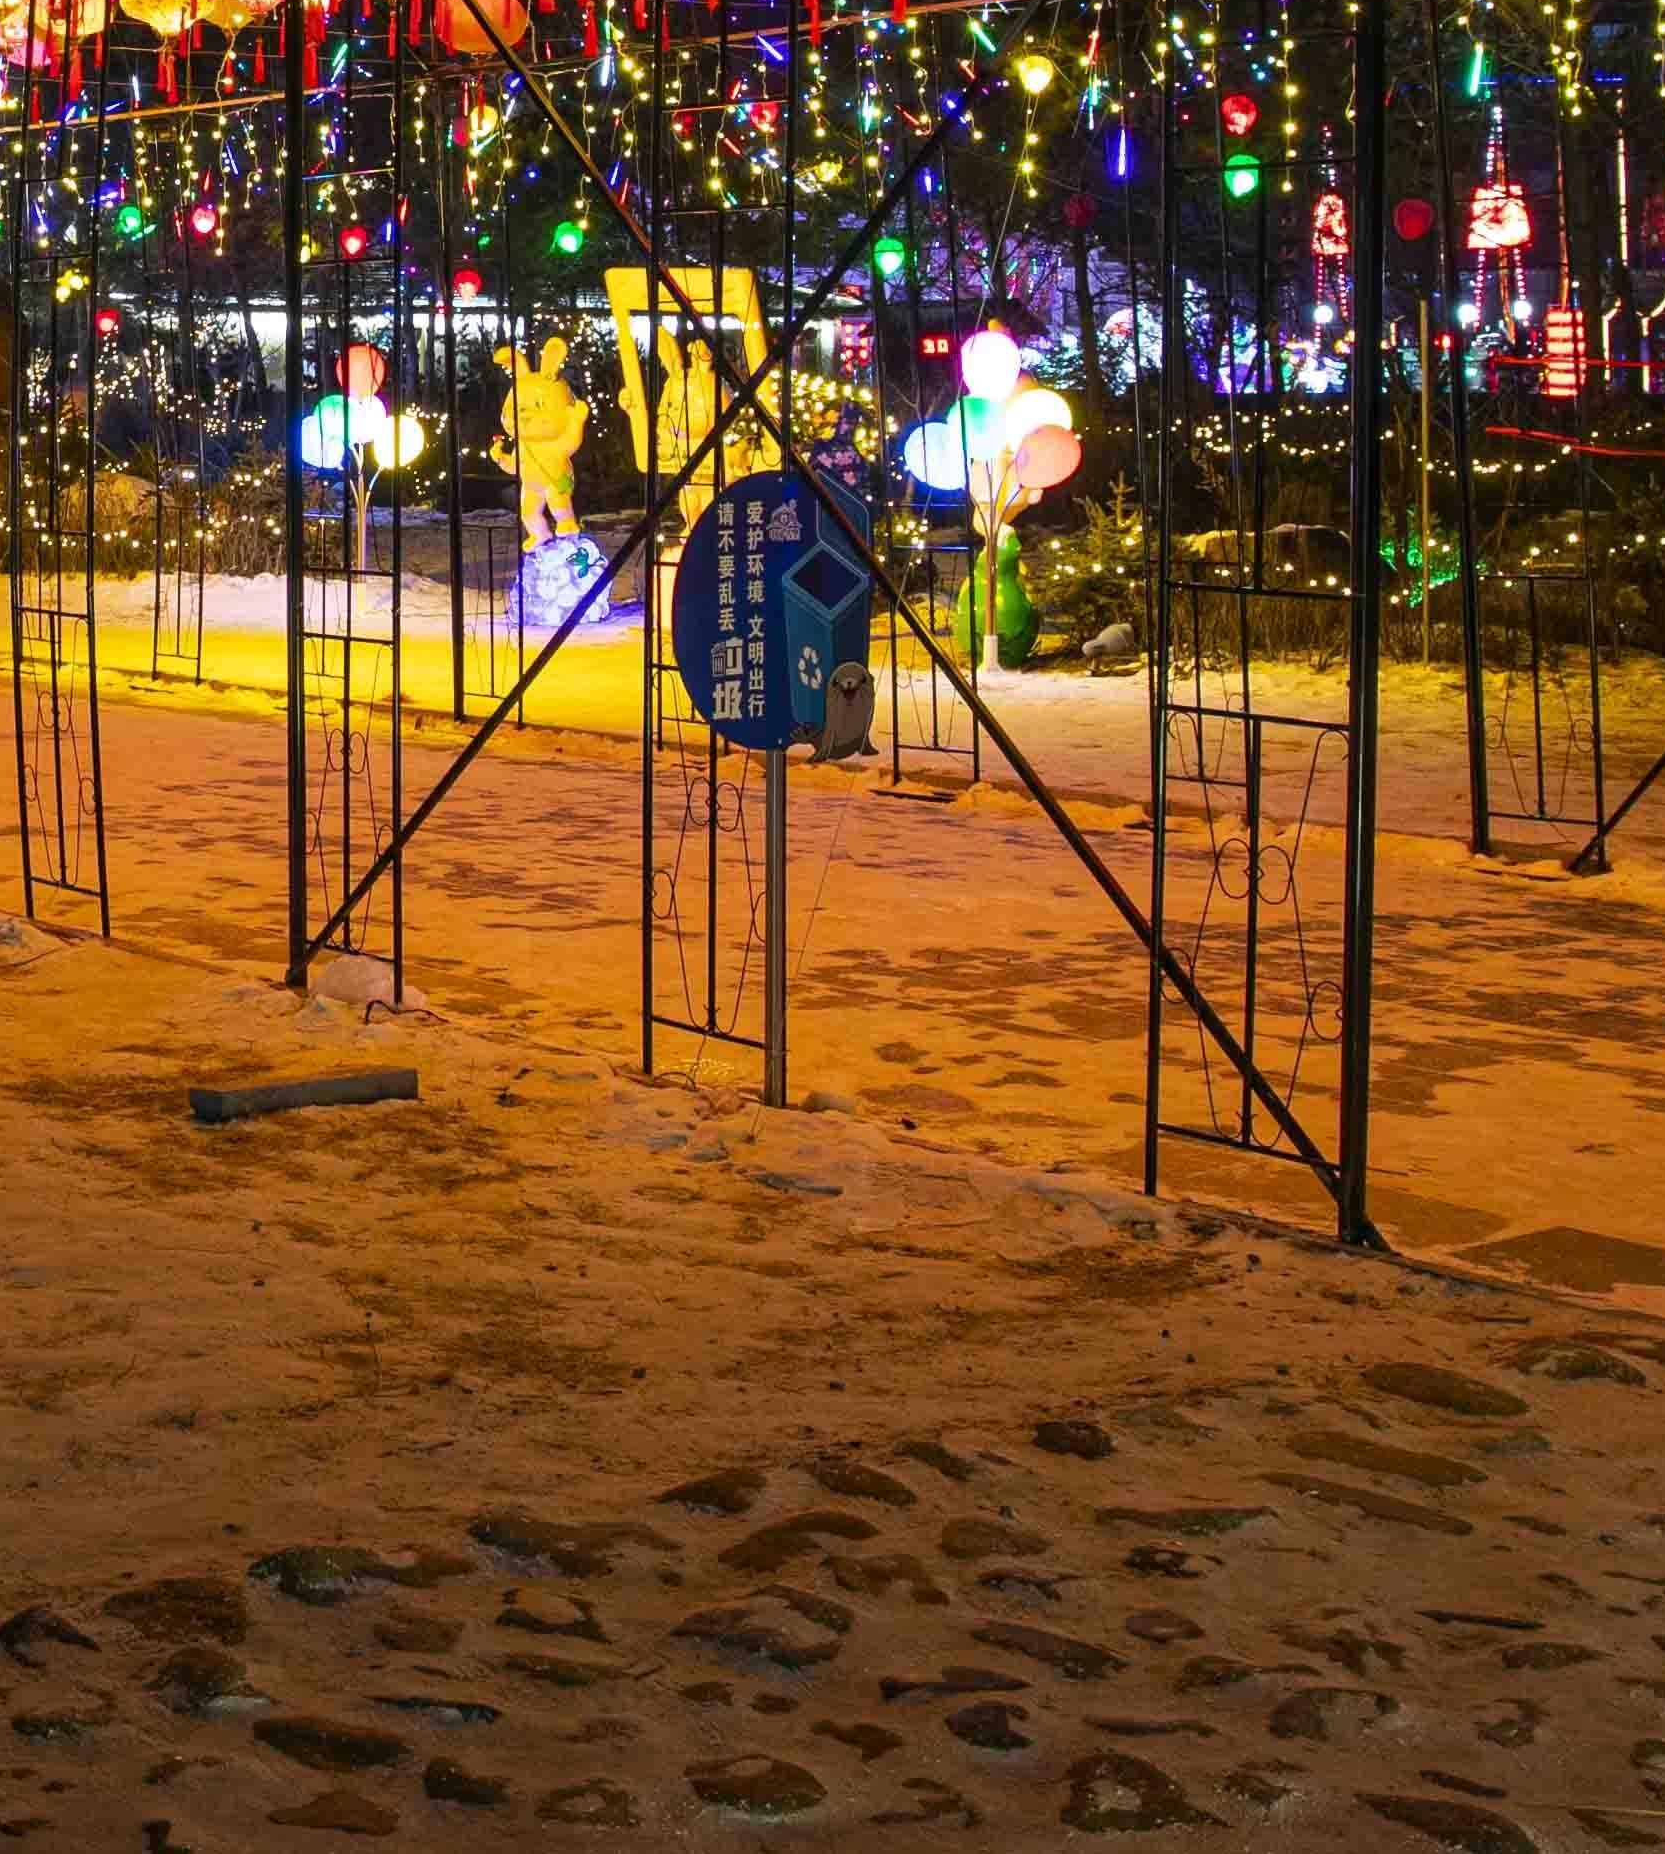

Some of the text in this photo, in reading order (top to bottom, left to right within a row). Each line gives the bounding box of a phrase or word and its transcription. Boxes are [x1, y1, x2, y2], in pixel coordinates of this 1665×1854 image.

[747, 501, 766, 719] 爱护环境 文明出行
